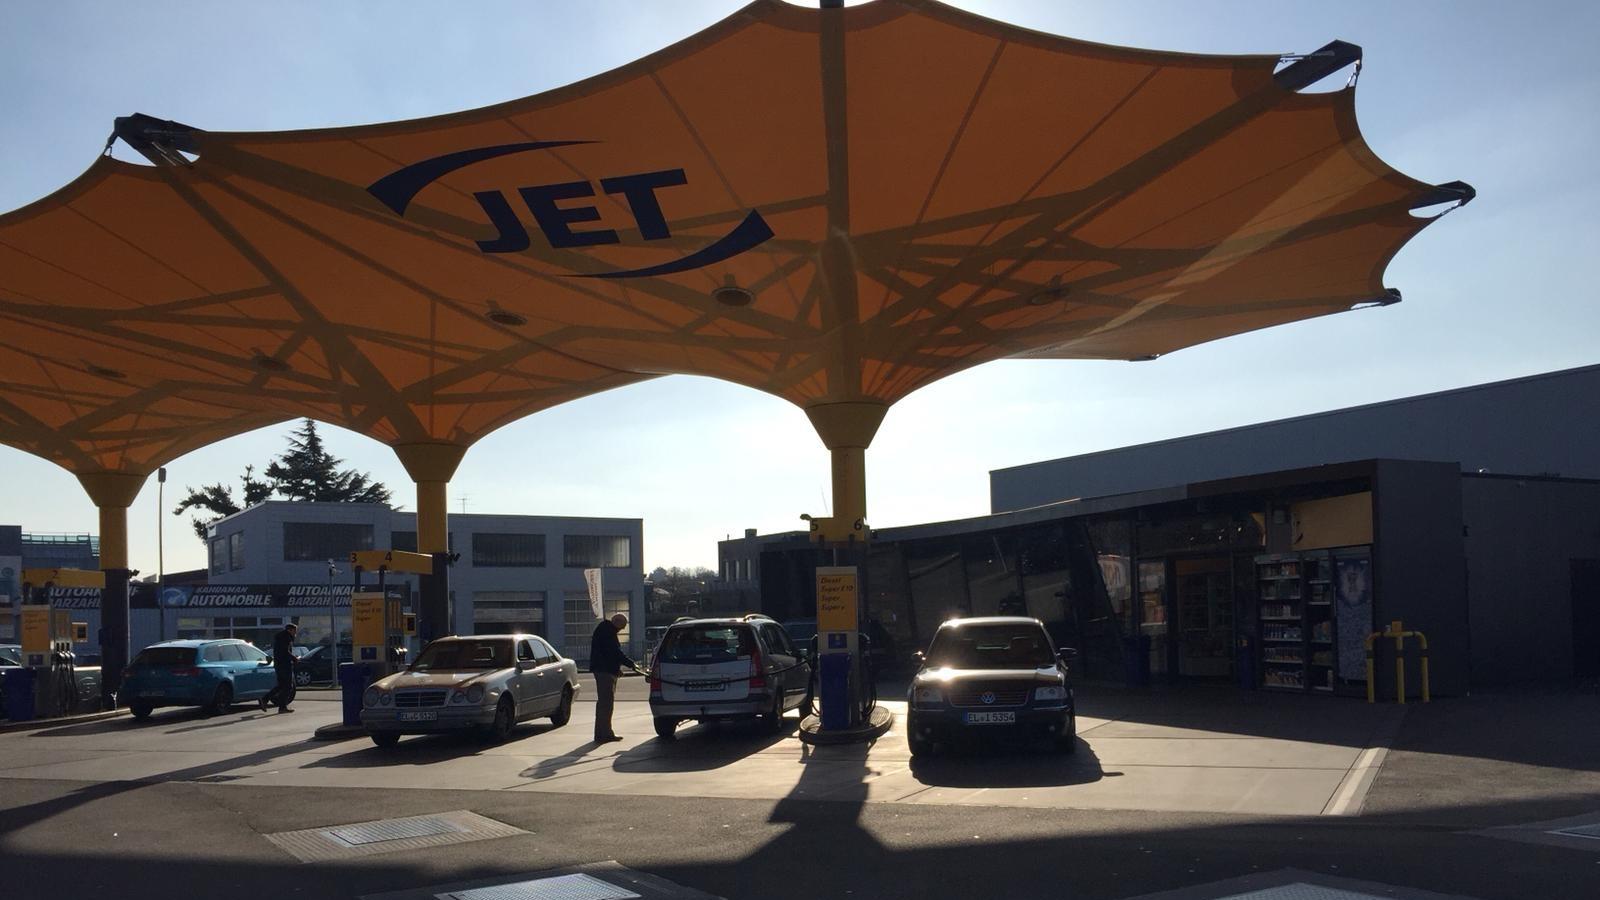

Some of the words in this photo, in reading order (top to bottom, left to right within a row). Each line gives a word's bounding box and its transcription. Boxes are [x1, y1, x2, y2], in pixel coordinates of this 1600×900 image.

[473, 168, 688, 253] JET
[811, 520, 818, 531] 5
[854, 519, 862, 530] 6
[351, 553, 357, 563] 3
[385, 552, 392, 562] 4
[52, 570, 58, 578] 2
[189, 595, 272, 606] AUTOMOBILE
